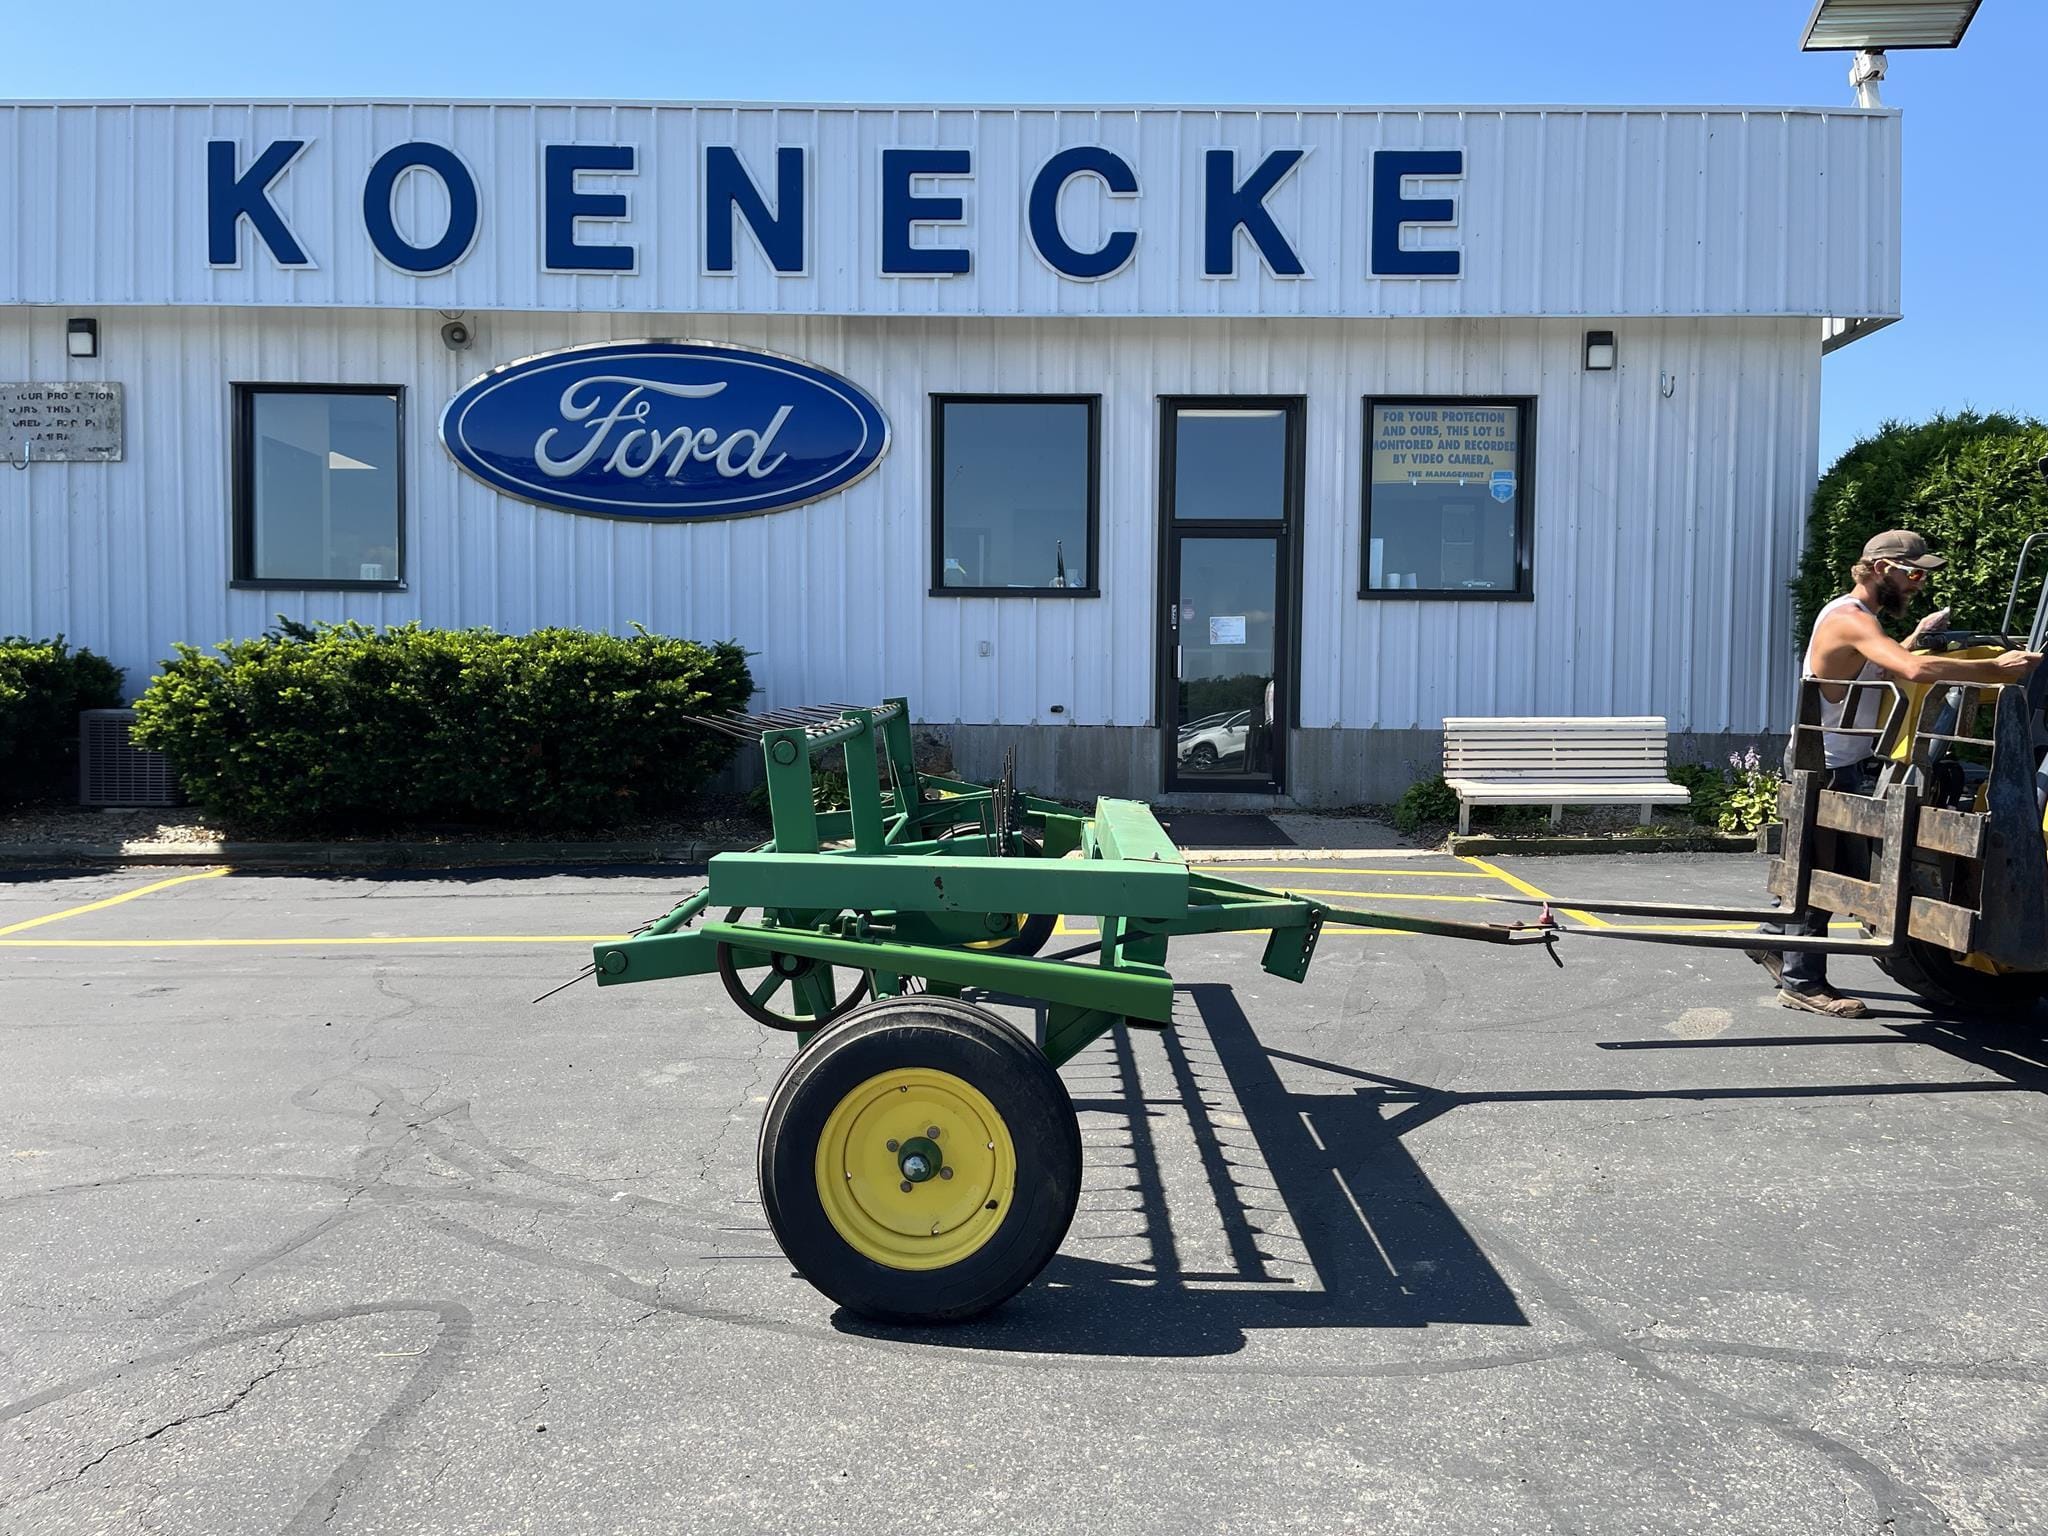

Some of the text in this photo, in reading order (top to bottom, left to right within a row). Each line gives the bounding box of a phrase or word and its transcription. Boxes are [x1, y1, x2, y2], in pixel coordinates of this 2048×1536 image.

[207, 140, 1463, 277] KOENECKE
[47, 392, 113, 400] PROETION
[1383, 411, 1505, 423] FOR YOUR PROTECTION
[535, 375, 792, 477] Ford
[1382, 425, 1505, 438] AND OURS, THIS LOT IS
[1438, 440, 1460, 450] AND
[1465, 440, 1517, 451] RECORDED
[1393, 453, 1493, 465] BY VIDEO CAMERA.
